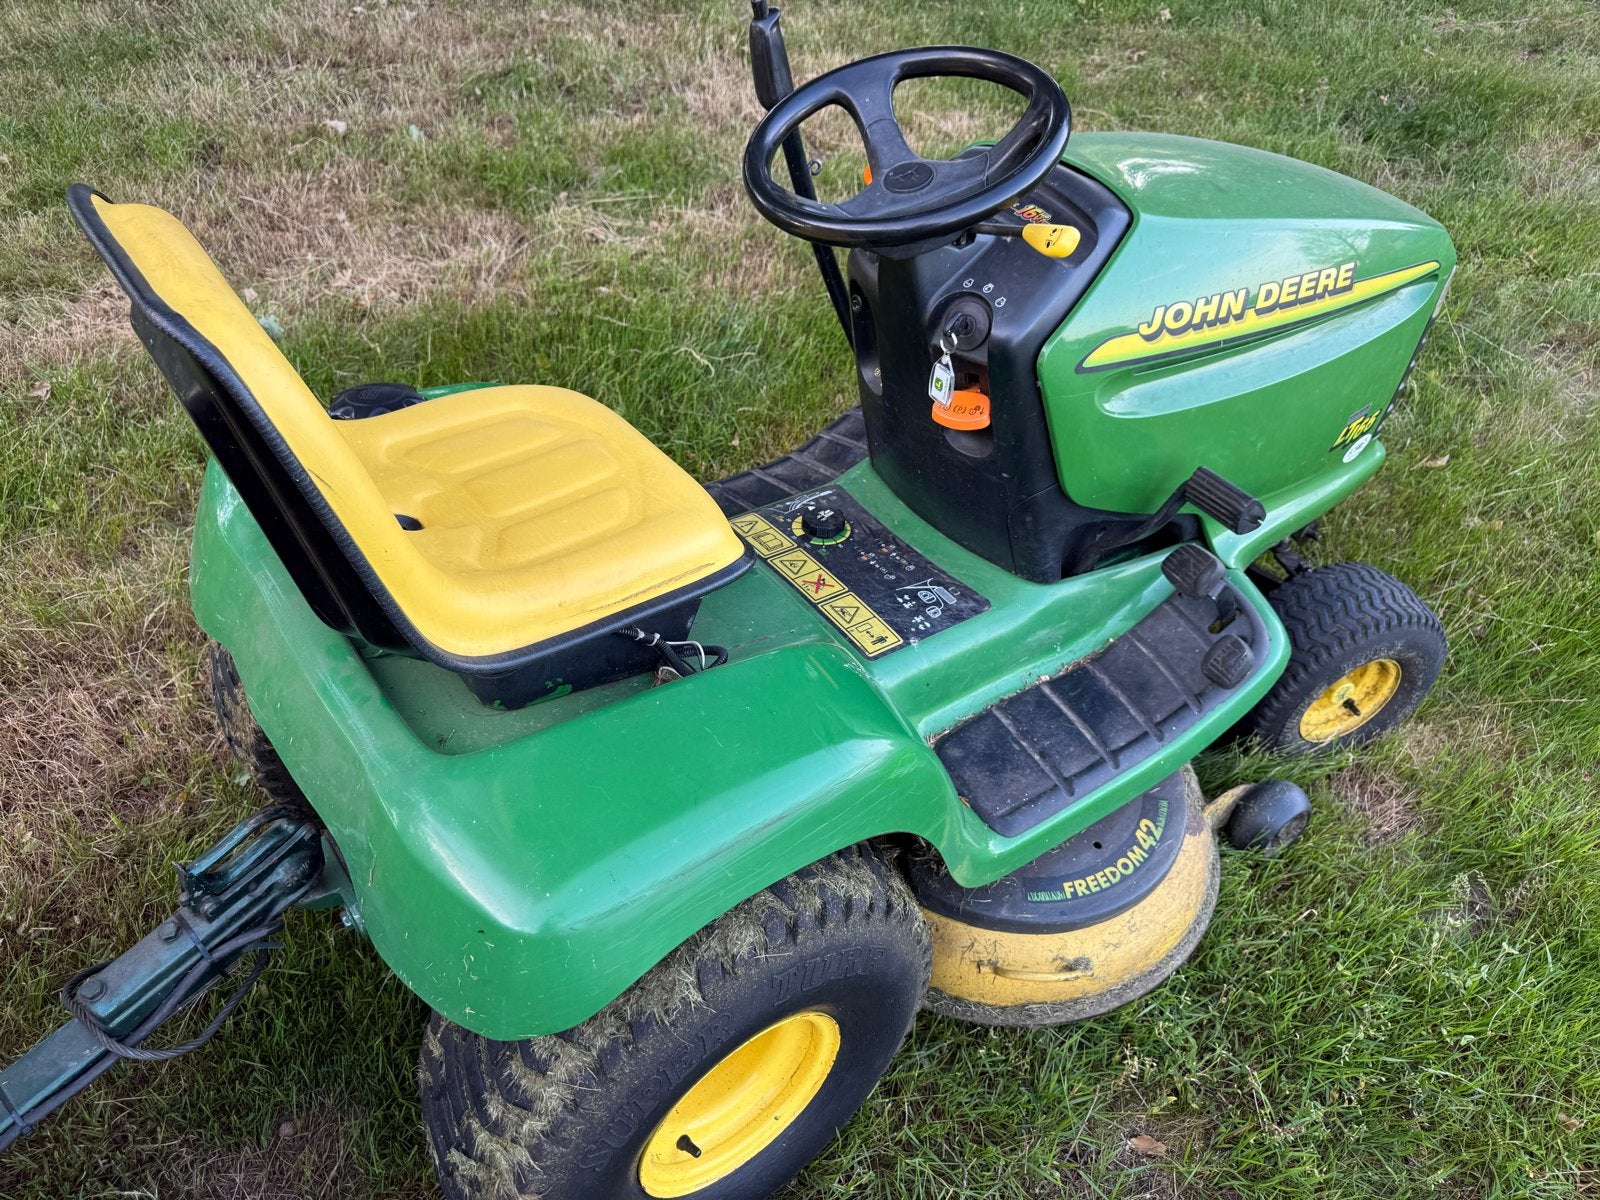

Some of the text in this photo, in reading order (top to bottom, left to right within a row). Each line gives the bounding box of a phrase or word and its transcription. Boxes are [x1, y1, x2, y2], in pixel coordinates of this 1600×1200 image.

[1138, 262, 1356, 340] JOHN DEERE
[1063, 818, 1162, 899] FREEDOM 42
[577, 945, 885, 1170] SUPER TURF
